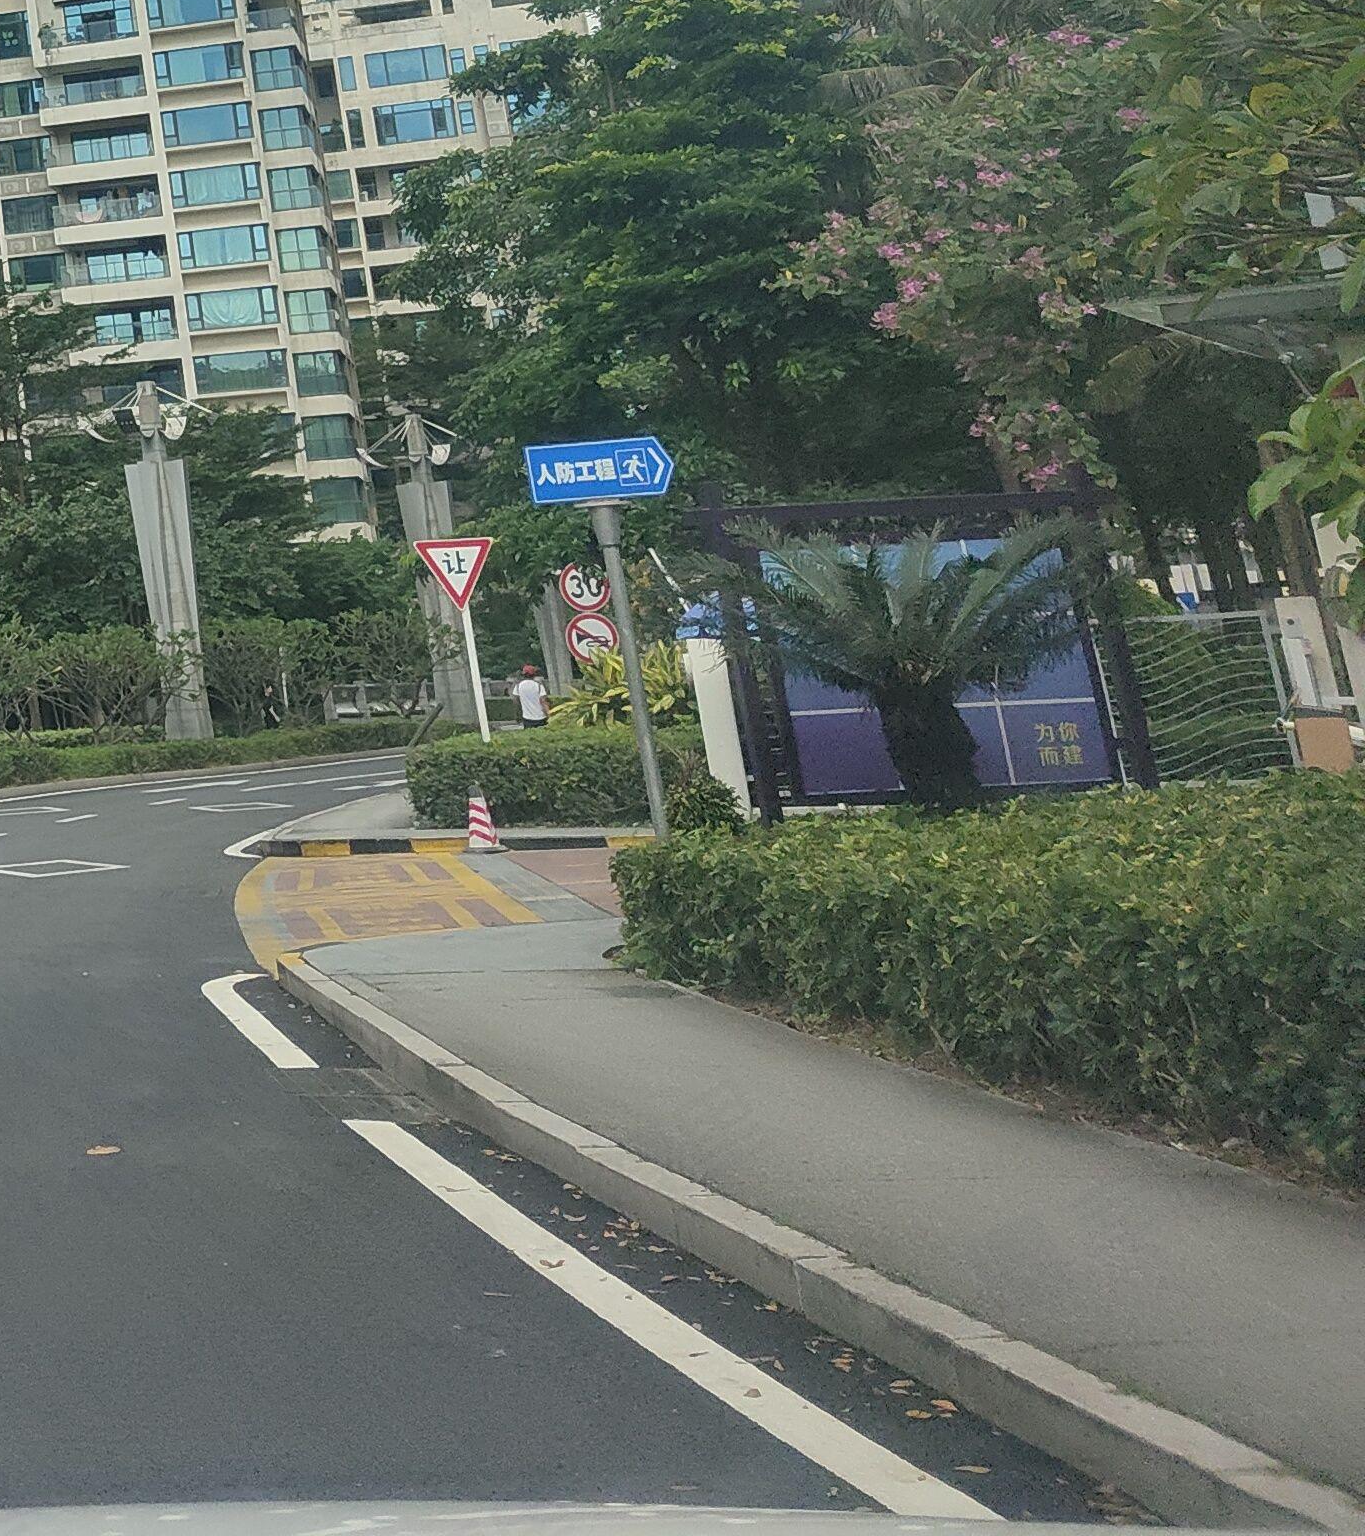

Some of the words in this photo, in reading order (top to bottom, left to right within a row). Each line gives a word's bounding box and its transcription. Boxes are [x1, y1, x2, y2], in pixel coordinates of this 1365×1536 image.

[537, 458, 617, 486] 人防工程
[442, 550, 467, 575] 让
[569, 571, 601, 598] 30
[1034, 721, 1080, 742] 为你
[1037, 745, 1084, 767] 而建
